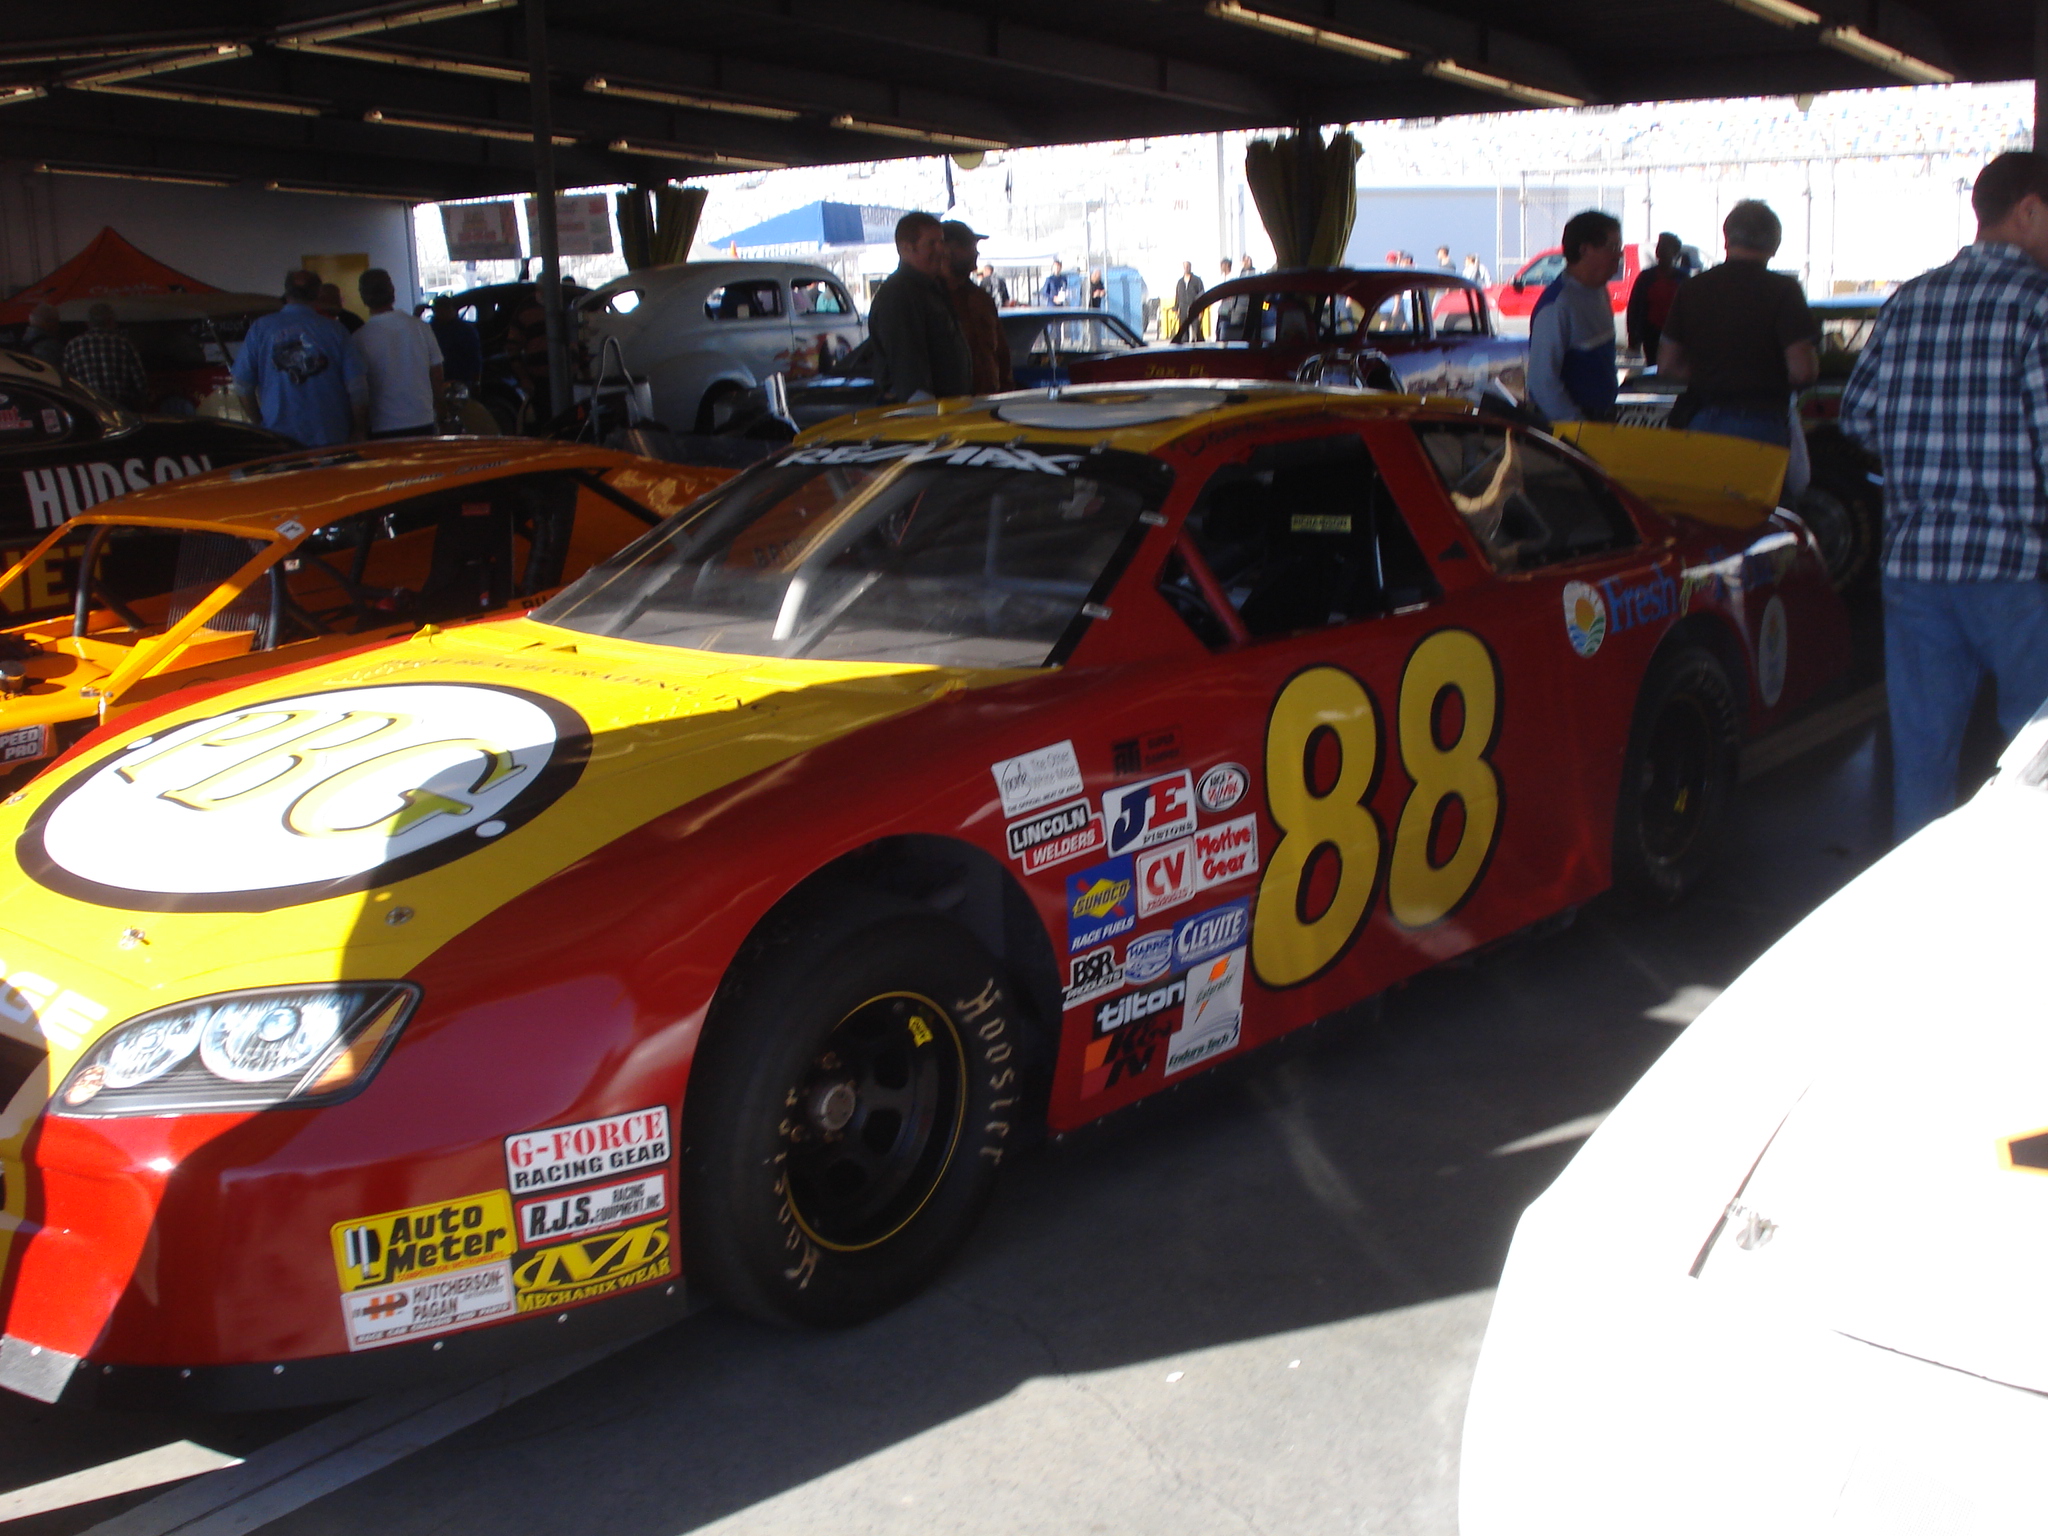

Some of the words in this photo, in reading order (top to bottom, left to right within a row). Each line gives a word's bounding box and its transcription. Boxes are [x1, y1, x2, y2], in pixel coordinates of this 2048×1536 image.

[1602, 560, 1679, 634] Fresh
[5, 741, 38, 761] PRO
[1012, 806, 1087, 850] LINCOLN
[1112, 775, 1188, 852] JE
[1250, 626, 1504, 988] 88
[1032, 827, 1096, 867] WELDERS
[1196, 824, 1251, 857] Motive
[1146, 850, 1186, 896] CV
[1202, 852, 1248, 880] Gear
[1076, 882, 1128, 914] SUNOCO
[1071, 926, 1104, 952] RACE
[1101, 914, 1136, 940] FUELS
[1177, 906, 1246, 955] CLEVITE
[1073, 950, 1114, 989] BSR
[0, 960, 109, 1051] GE
[1095, 979, 1187, 1033] tilton
[954, 977, 1021, 1167] Hoosier
[509, 1111, 665, 1169] G-FORCE
[514, 1155, 604, 1190] RACING
[609, 1142, 666, 1169] GEAR
[611, 1181, 647, 1203] RACING
[387, 1205, 484, 1247] Auto
[385, 1226, 508, 1284] Meter
[411, 1294, 459, 1323] PAGAN
[515, 1279, 620, 1314] MECHANIX
[619, 1257, 673, 1289] WEAR
